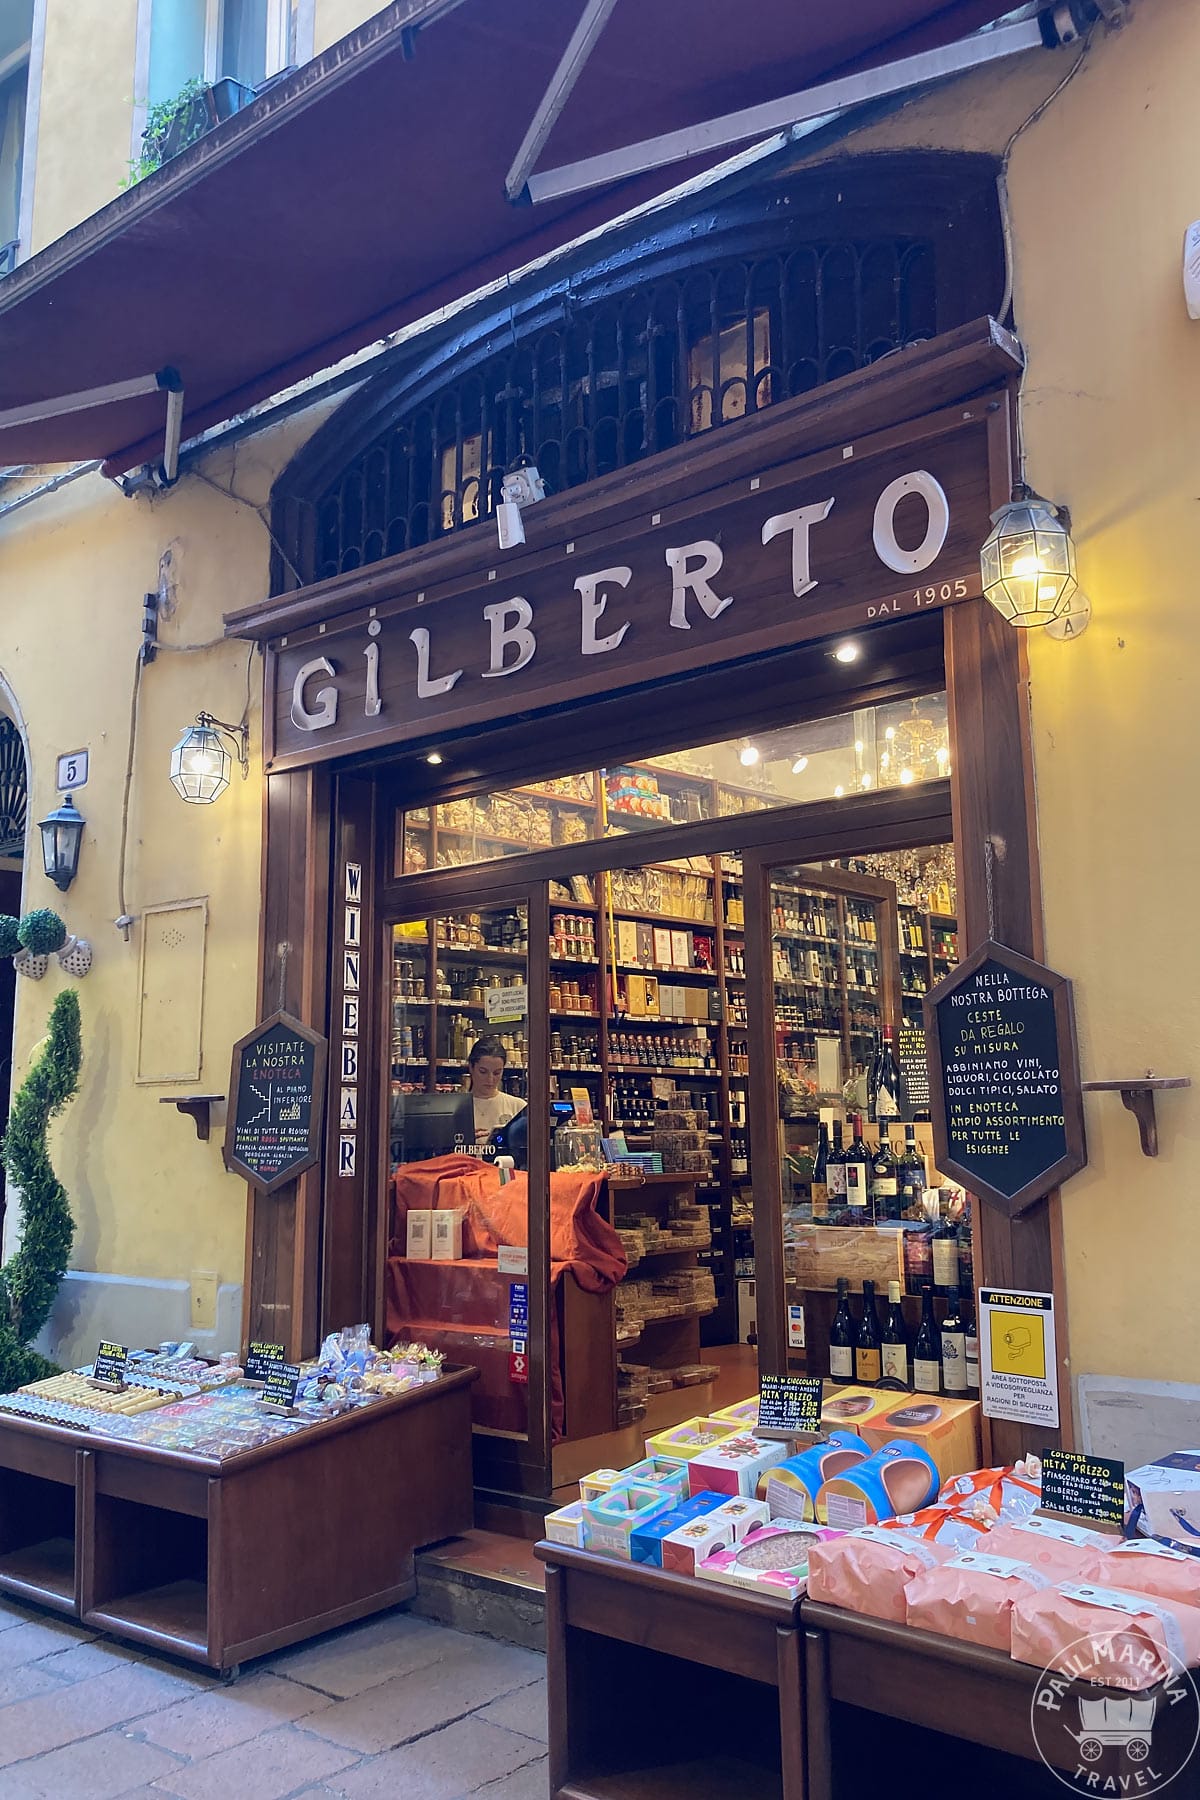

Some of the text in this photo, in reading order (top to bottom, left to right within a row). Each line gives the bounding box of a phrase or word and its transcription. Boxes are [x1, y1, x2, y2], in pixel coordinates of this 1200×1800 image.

[867, 580, 967, 617] DAL 1905
[66, 760, 77, 782] 5
[975, 973, 1010, 987] NELLA
[951, 986, 1048, 1007] NOSTRA BOTTEGA
[967, 1009, 1002, 1024] CESTE
[960, 1022, 1025, 1042] DA REGALO
[256, 1041, 305, 1055] VISITATE
[954, 1041, 1019, 1057] SU MISURA
[246, 1055, 305, 1067] LA NOSTRA
[946, 1058, 1042, 1073] ABBINIAMO VINI,
[253, 1068, 301, 1080] ENOTECA
[947, 1070, 1059, 1084] LIQUORI, CIOCCOLATO
[276, 1085, 307, 1093] AL PIANO
[948, 1084, 1058, 1096] DOLCI TIPICI, SALATO
[273, 1096, 312, 1104] INFERIORE
[950, 1102, 1019, 1114] IN ENOTECA
[951, 1116, 1065, 1127] AMPIO ASSORTIMENTO
[951, 1131, 1020, 1141] PER TUTTE LE
[454, 1144, 496, 1155] GILBERTO
[966, 1145, 1009, 1155] ESIGENZE
[989, 1293, 1043, 1308] ATTENZIONE
[762, 1375, 778, 1383] UOVA
[787, 1377, 820, 1386] CIOCCOLATO
[1008, 1377, 1047, 1387] SOTTOPOSTA
[991, 1382, 1053, 1396] VIDEOSORVEGLIANZA
[1020, 1401, 1053, 1412] SICUREZZA
[1050, 1450, 1087, 1463] COLOMBE
[1072, 1463, 1110, 1478] PREZZO
[1045, 1485, 1079, 1496] GILBERTO
[1045, 1500, 1057, 1509] SAL
[1065, 1504, 1083, 1514] RISO
